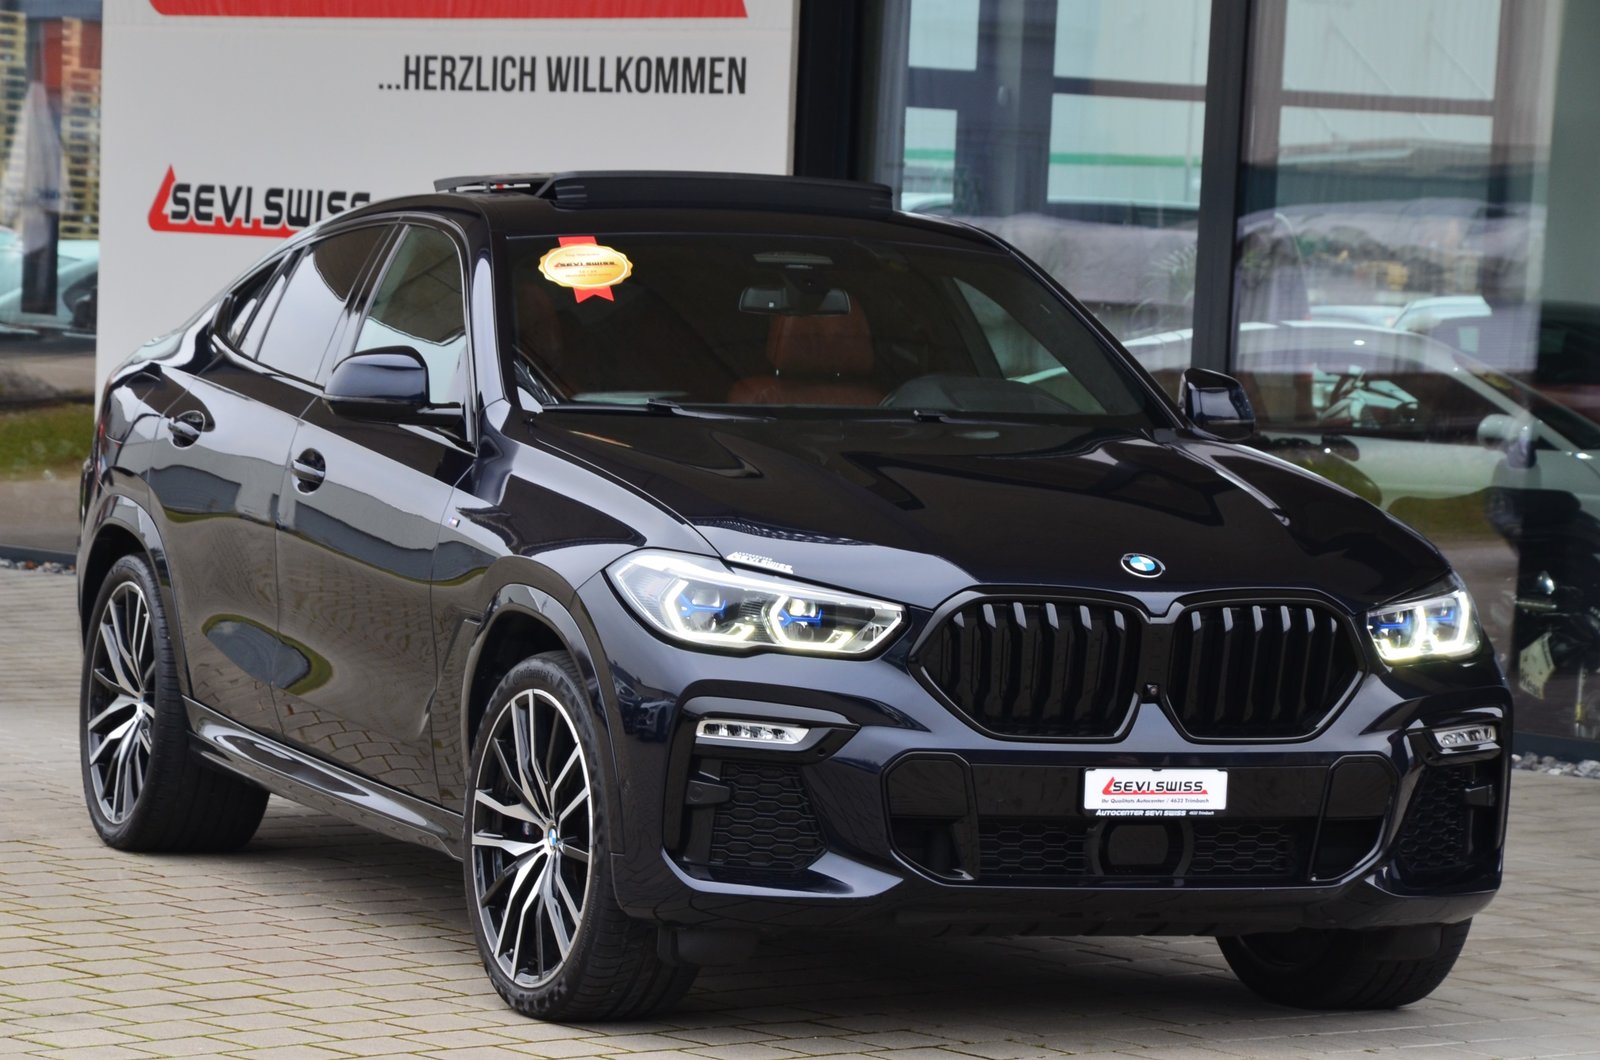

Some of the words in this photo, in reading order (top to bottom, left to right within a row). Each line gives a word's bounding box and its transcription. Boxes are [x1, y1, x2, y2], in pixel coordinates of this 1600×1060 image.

[378, 54, 537, 92] ...HERZLICH
[546, 55, 747, 95] WILLKOMMEN
[170, 182, 254, 225] SEVI
[1112, 781, 1151, 792] SEVI
[1155, 781, 1204, 792] SWISS
